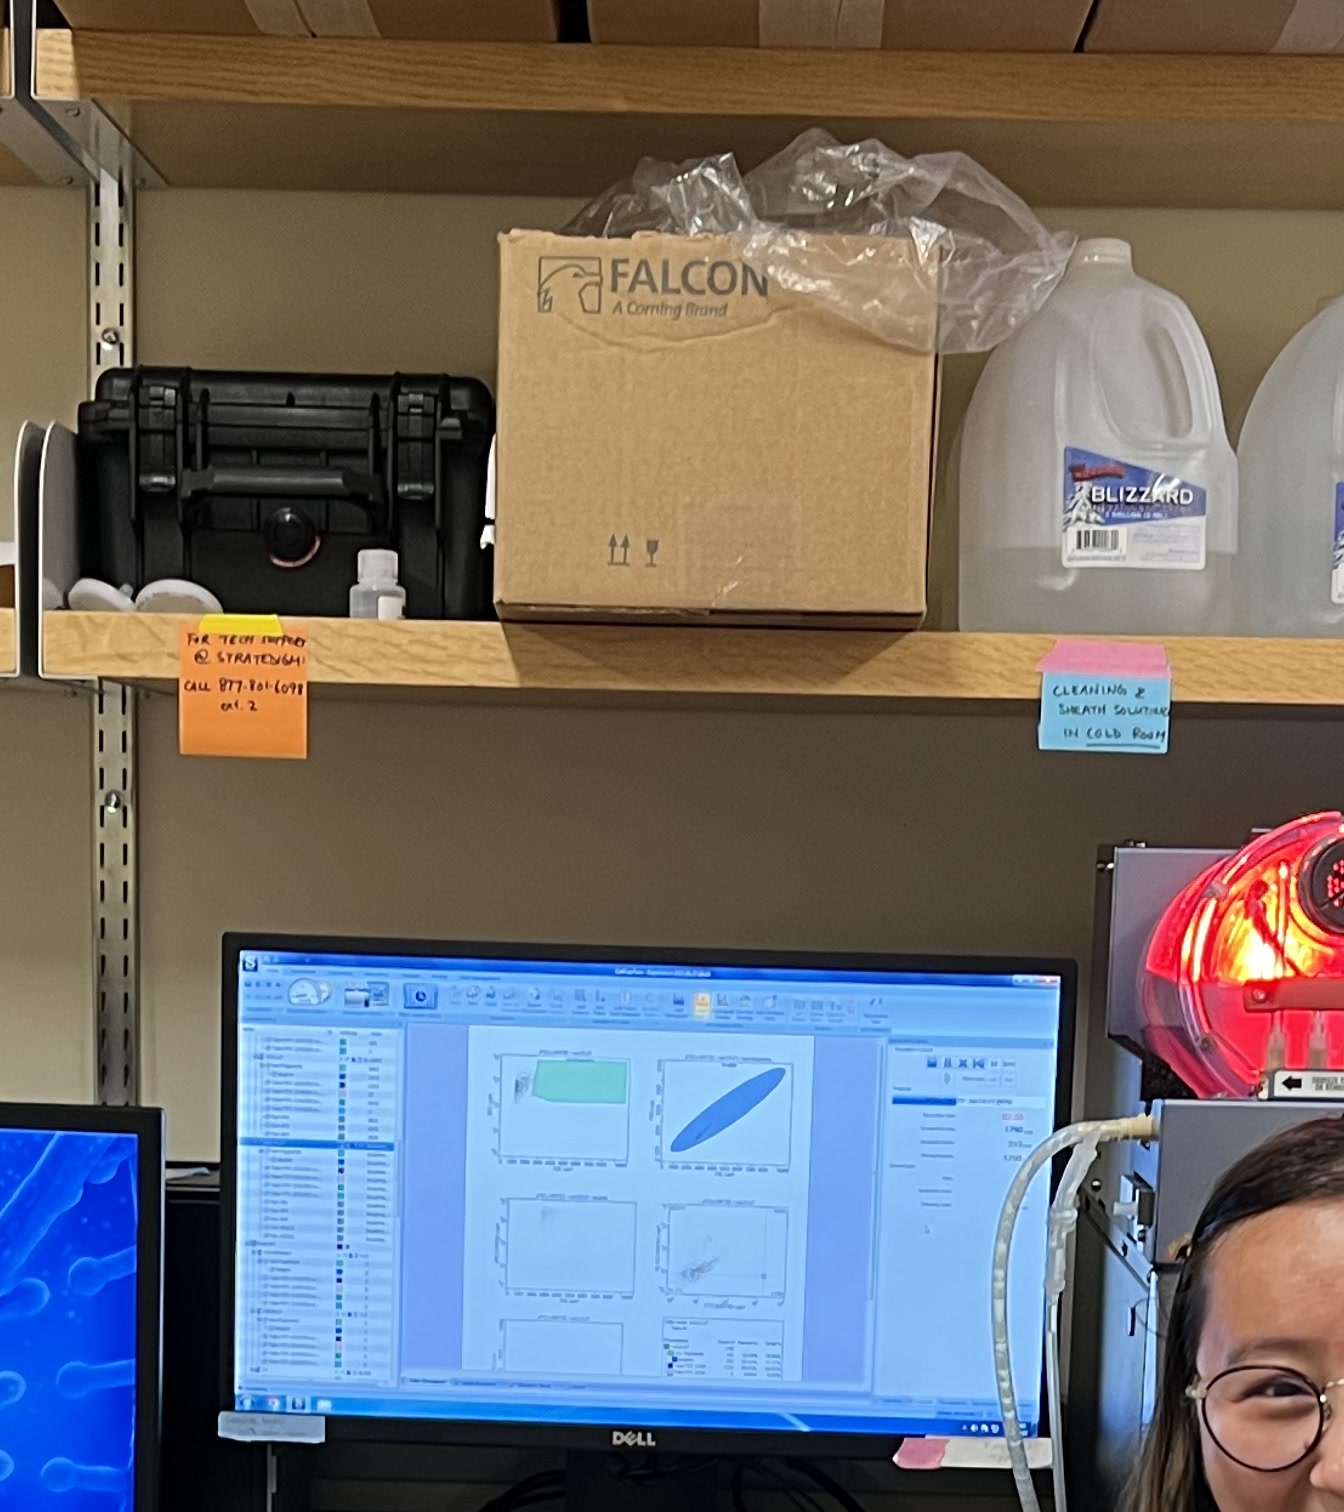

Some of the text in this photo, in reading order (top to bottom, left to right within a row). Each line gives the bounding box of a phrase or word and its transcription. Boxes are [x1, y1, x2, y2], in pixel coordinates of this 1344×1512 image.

[610, 258, 768, 297] FALCON
[685, 303, 728, 317] Brand
[1091, 486, 1194, 505] BLIZZARD
[187, 633, 210, 645] FOR
[194, 649, 211, 664] @
[184, 680, 211, 692] CALL
[1053, 684, 1127, 697] CLEANING
[248, 700, 258, 711] 2
[1058, 703, 1106, 716] SHEATH
[1063, 727, 1166, 743] IN COLD ROOM
[612, 1430, 656, 1447] DELL
